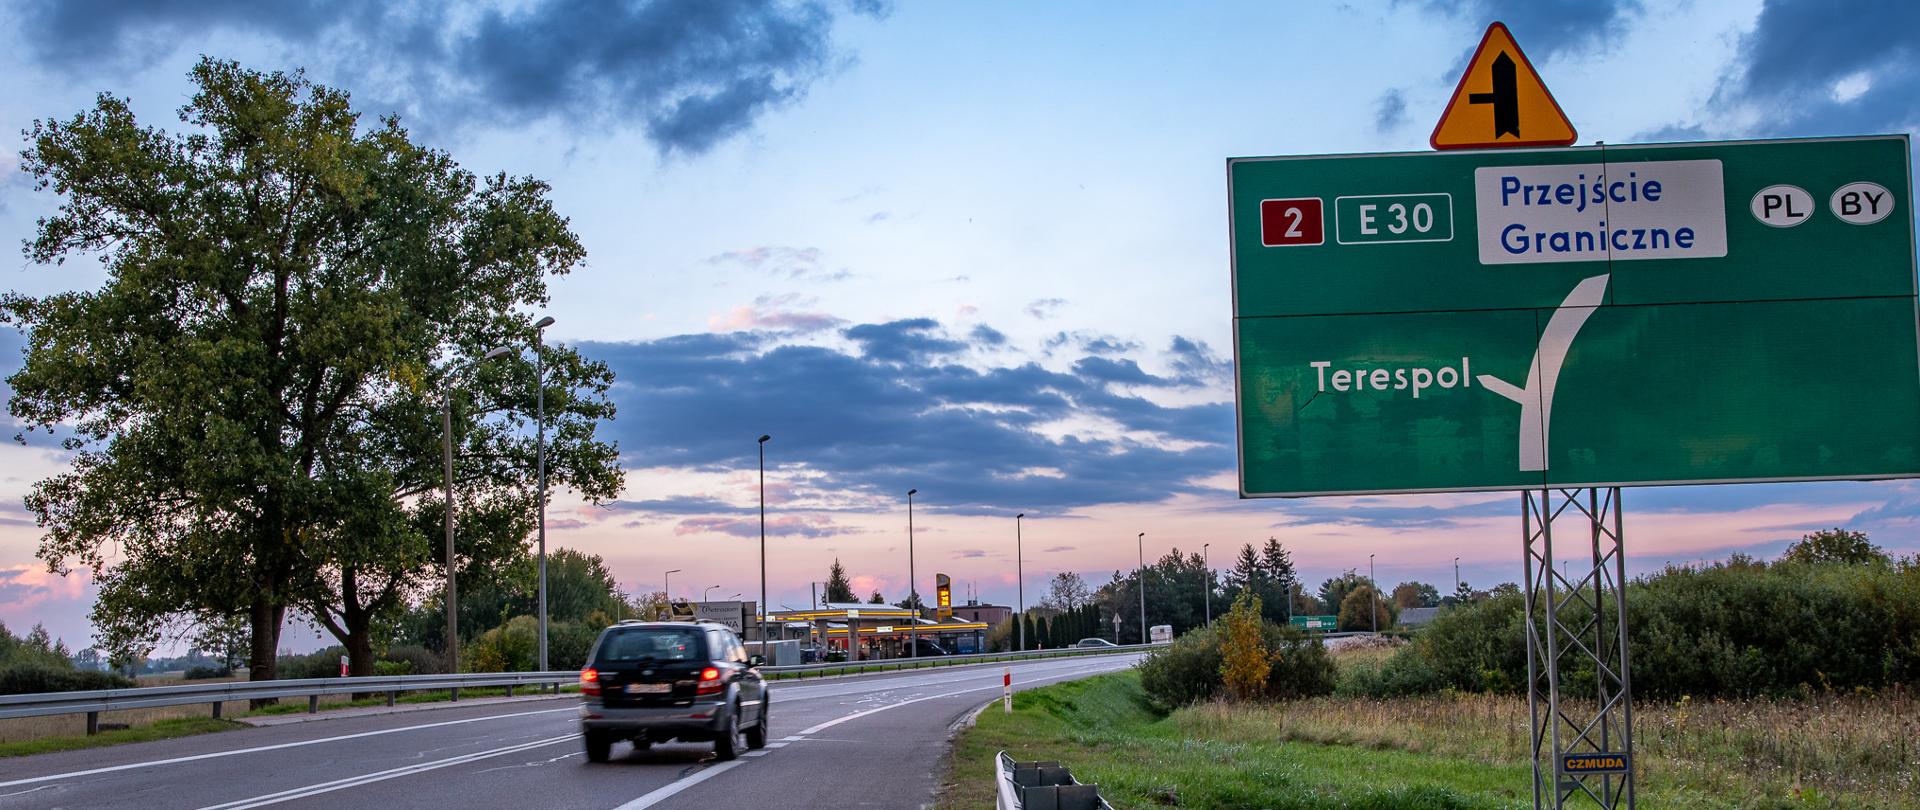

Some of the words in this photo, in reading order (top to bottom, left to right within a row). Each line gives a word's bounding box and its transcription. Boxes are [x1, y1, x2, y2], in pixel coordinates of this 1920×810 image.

[1500, 172, 1662, 213] Przejście
[1763, 194, 1804, 219] PL
[1840, 191, 1885, 216] BY
[1284, 207, 1303, 238] 2
[1500, 221, 1695, 254] Graniczne
[1310, 357, 1470, 398] Terespol
[1567, 758, 1624, 769] CZMUDA
